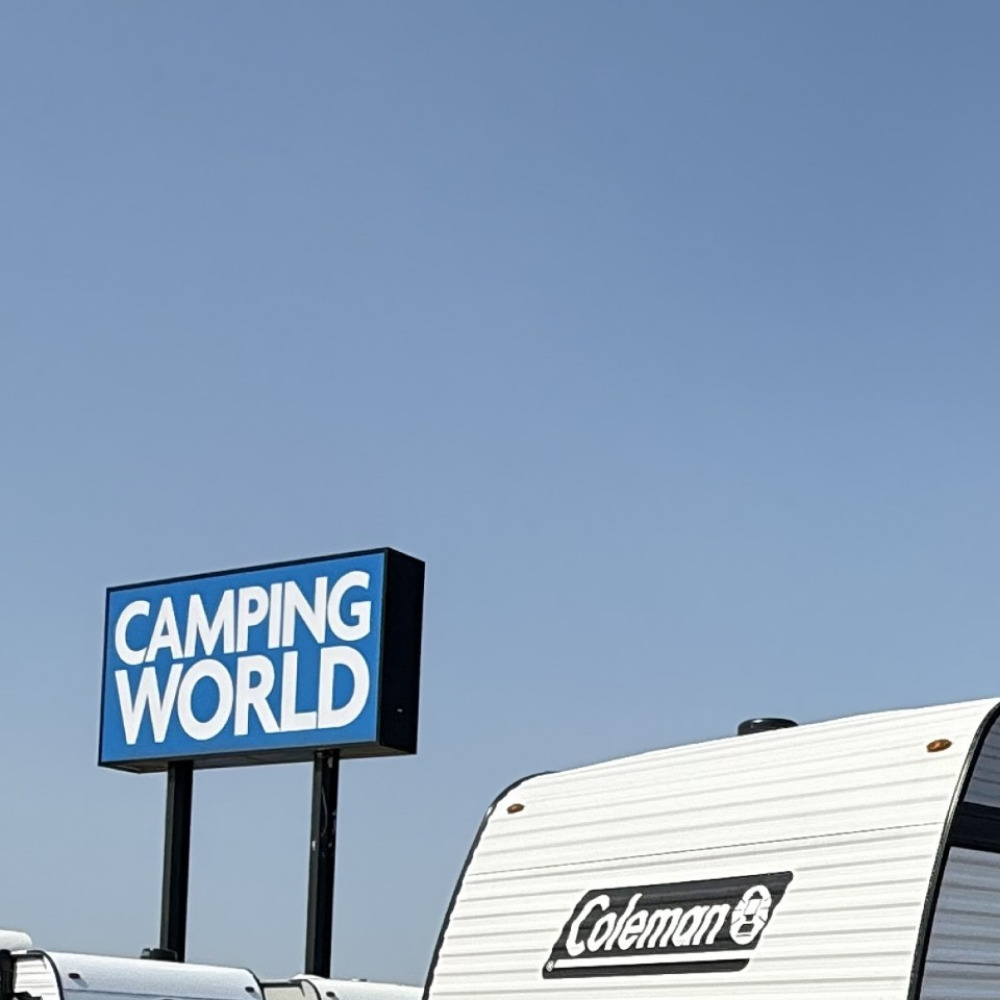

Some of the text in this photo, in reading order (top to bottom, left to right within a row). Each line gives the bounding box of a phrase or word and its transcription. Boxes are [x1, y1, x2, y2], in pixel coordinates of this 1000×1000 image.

[114, 570, 371, 666] CAMPING
[114, 645, 370, 745] WORLD
[565, 893, 731, 957] Coleman
